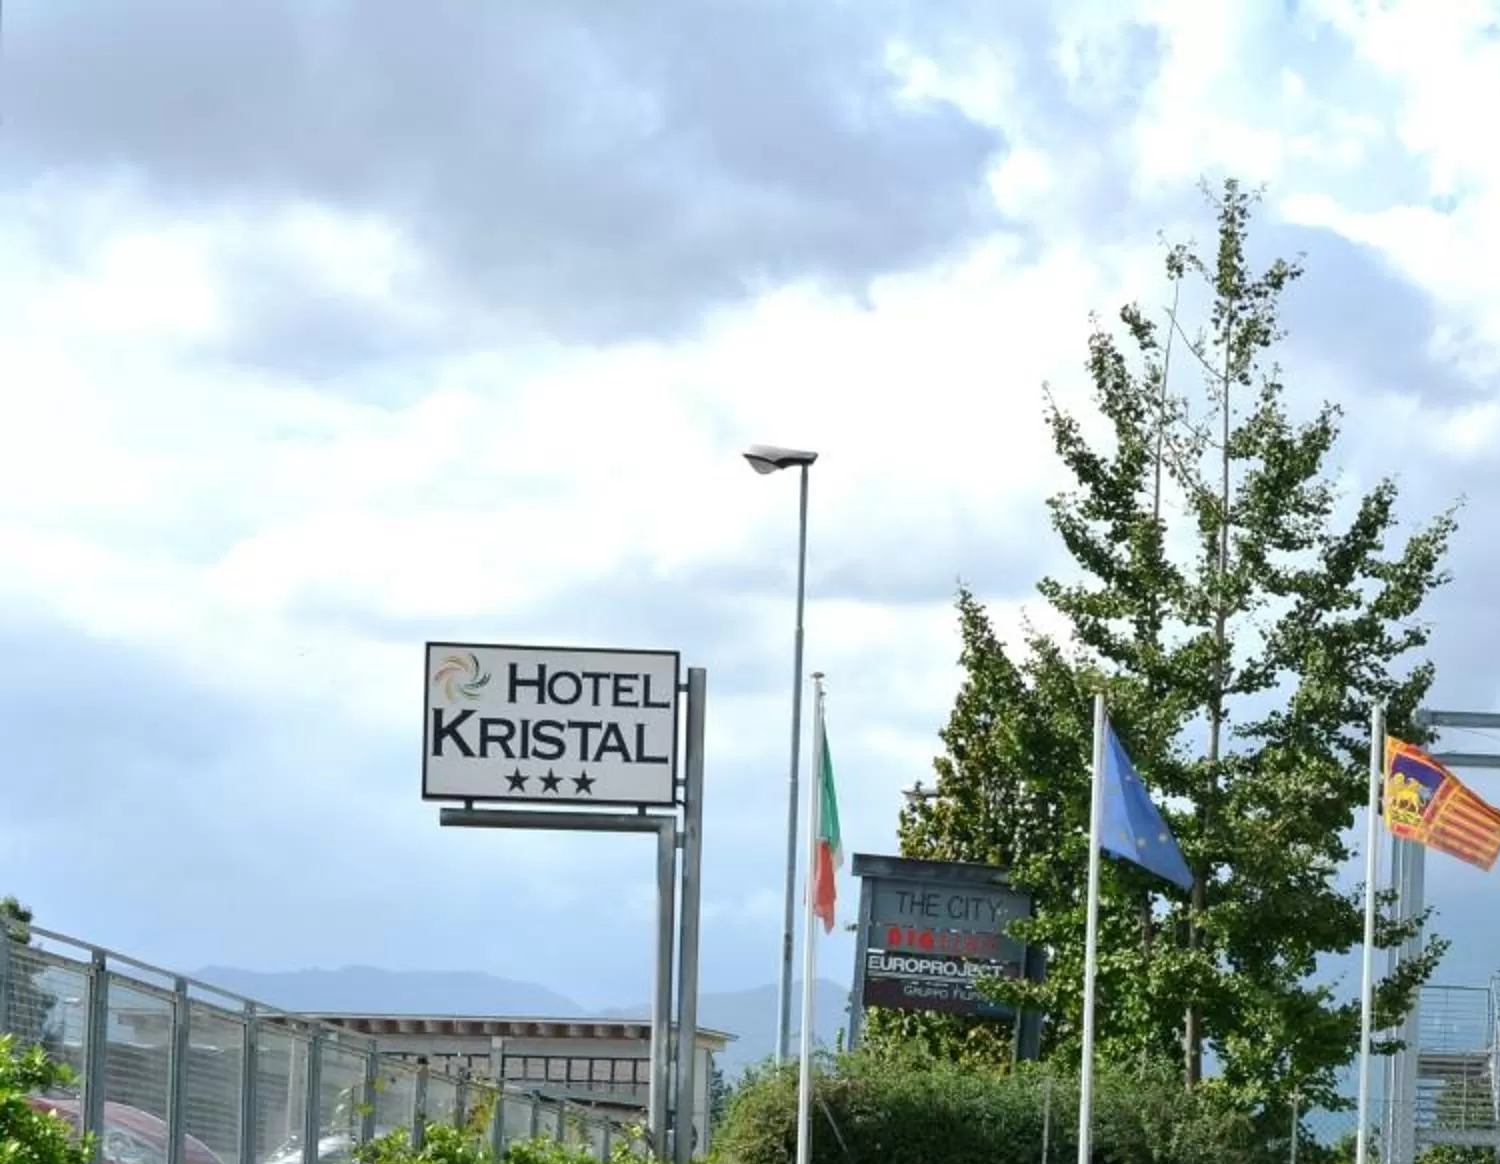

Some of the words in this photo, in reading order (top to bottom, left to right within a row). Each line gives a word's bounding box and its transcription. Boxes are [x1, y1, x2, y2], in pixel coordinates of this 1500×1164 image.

[507, 663, 671, 709] HOTEL
[432, 707, 669, 764] KRISTAL
[896, 890, 941, 918] THE
[947, 894, 1001, 923] CITY
[868, 955, 1004, 978] EUROPROJECT
